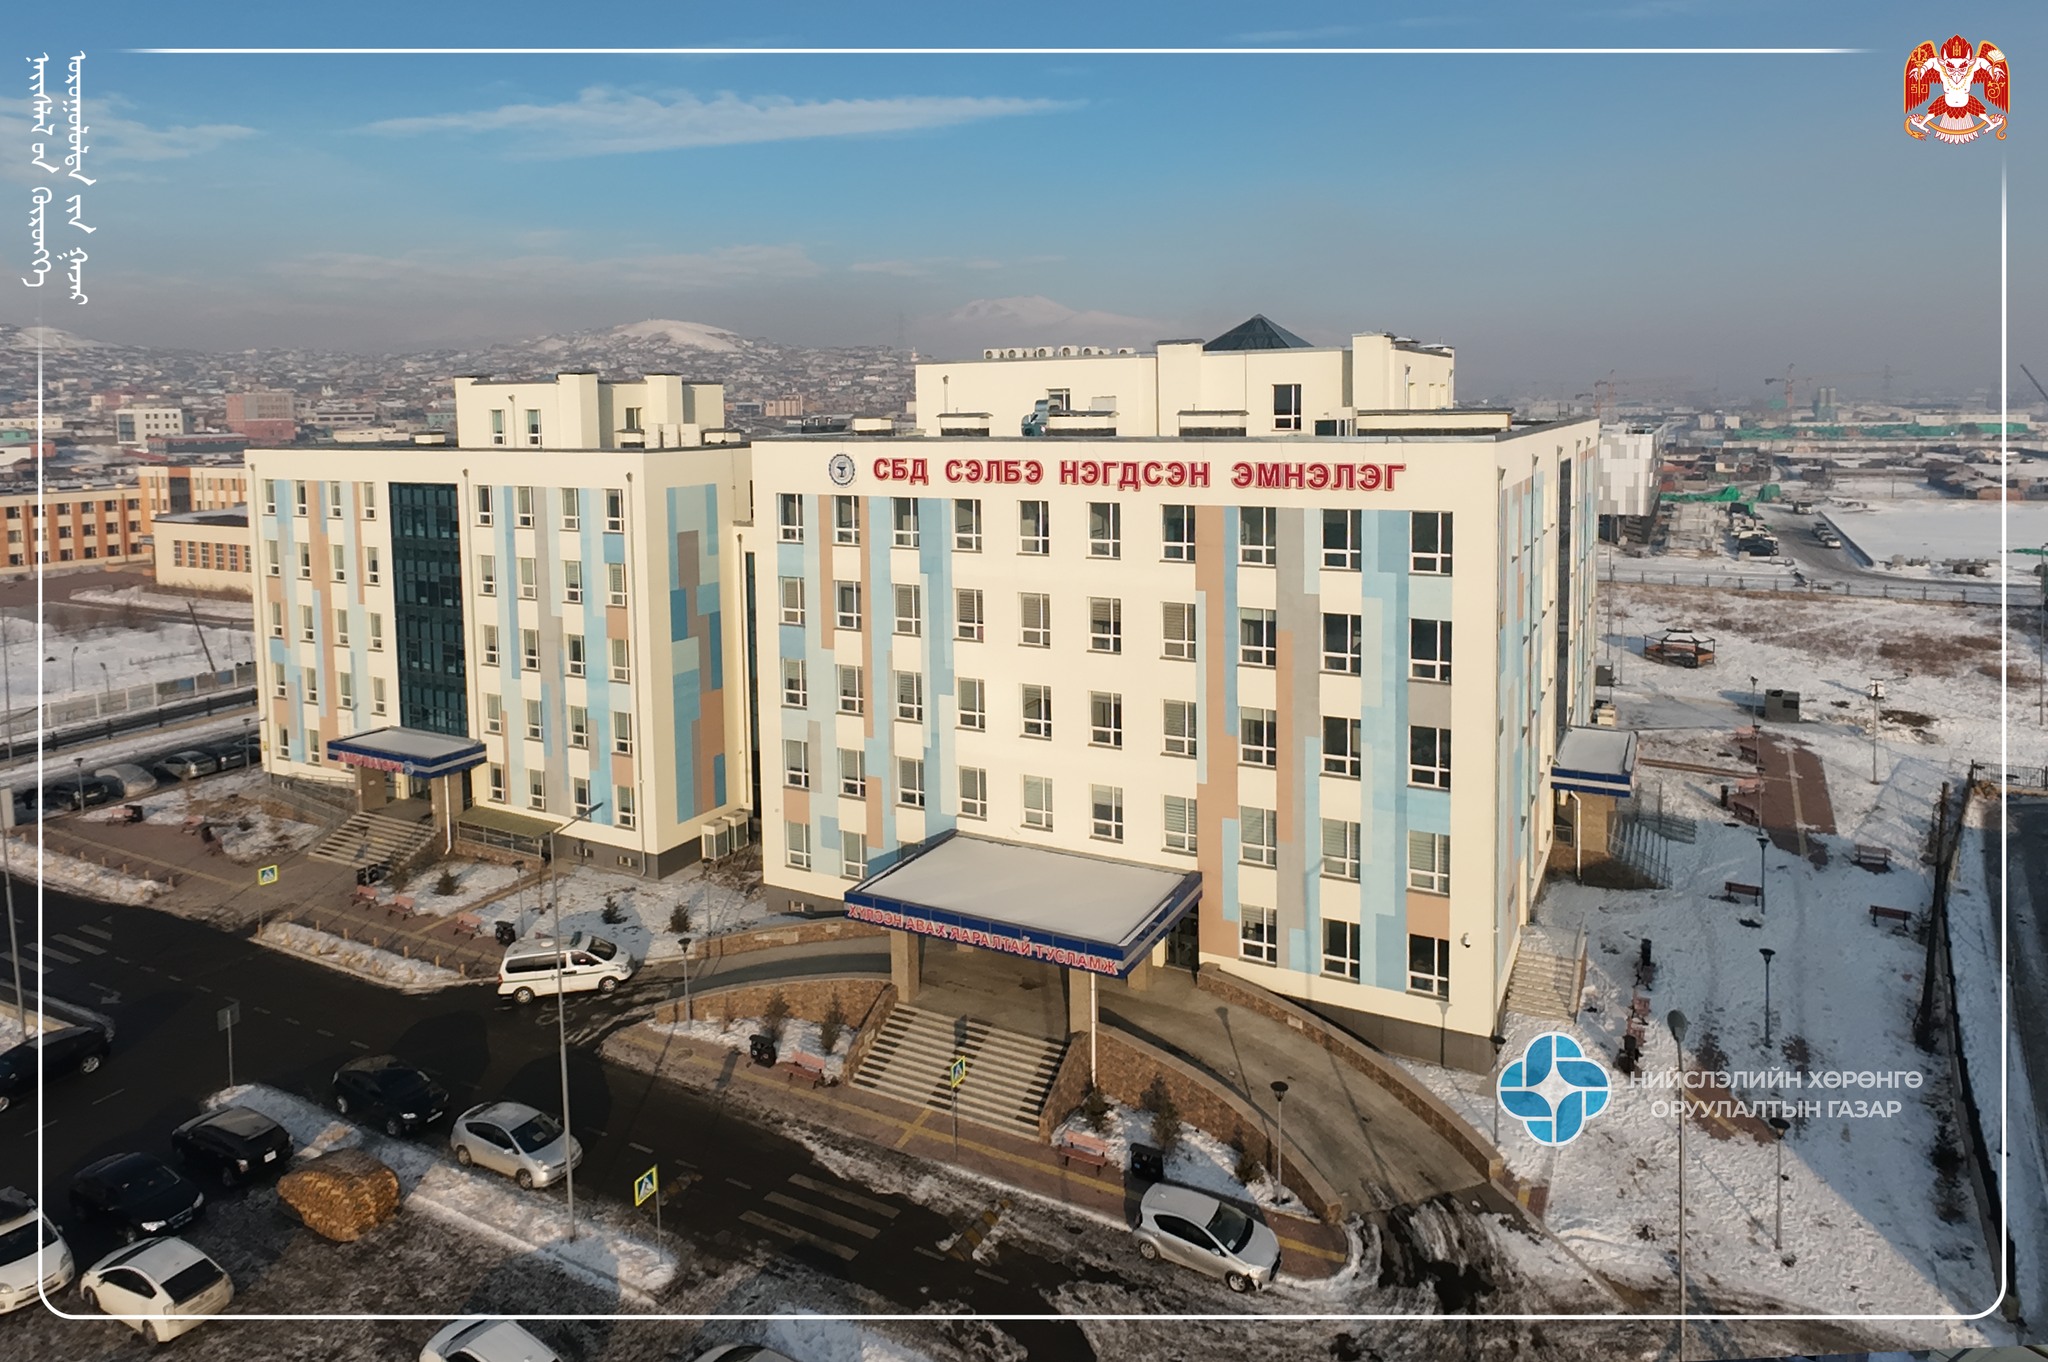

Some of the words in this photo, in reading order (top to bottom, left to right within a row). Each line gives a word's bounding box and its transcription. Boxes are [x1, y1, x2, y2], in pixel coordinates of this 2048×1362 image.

[873, 457, 929, 486] СБД
[944, 458, 1044, 485] СЭЛБЭ
[1059, 459, 1211, 492] НЭГДСЭН
[1231, 461, 1406, 492] ЭМНЭЛЭГ
[848, 904, 904, 927] ХҮЛЭЭН
[905, 917, 948, 939] АВАХ
[949, 926, 1032, 956] ЯАРАЛТАЙ
[1035, 944, 1119, 975] ТУСЛАМЖ
